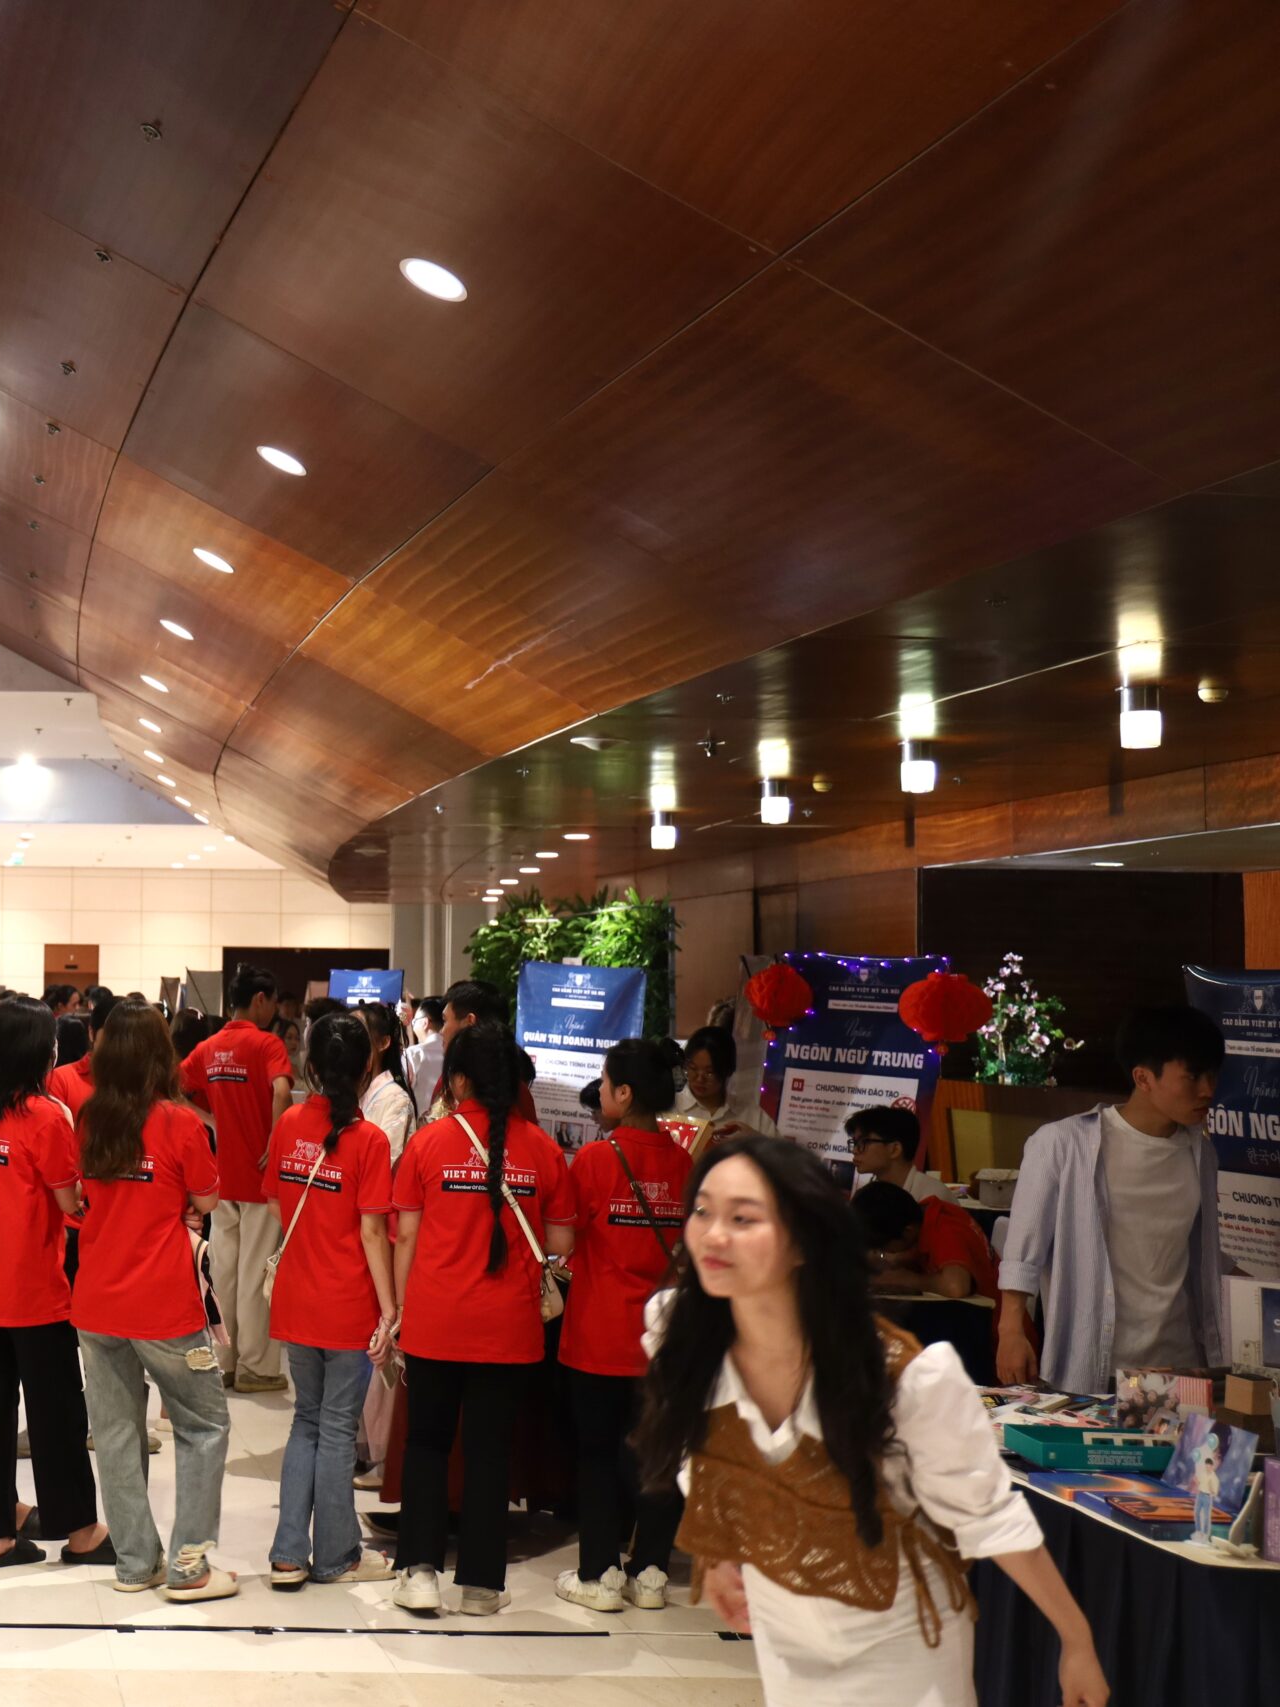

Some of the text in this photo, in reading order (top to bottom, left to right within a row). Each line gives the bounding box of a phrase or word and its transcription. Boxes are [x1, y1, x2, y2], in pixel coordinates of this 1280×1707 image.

[523, 1030, 619, 1049] QUẢN TRỊ DOANH NGH
[785, 1043, 924, 1069] NGÔN NGỮ TRUNG
[847, 1085, 867, 1095] TRÌNH
[868, 1086, 884, 1097] ĐÀO
[885, 1089, 899, 1100] TẠO
[1206, 1103, 1280, 1142] GÔN NG
[807, 1141, 818, 1149] CƠ
[819, 1142, 832, 1152] HỘI
[294, 1163, 306, 1172] MY
[308, 1165, 342, 1180] CLLEGE
[443, 1170, 535, 1184] VIET MY LLEGE
[610, 1203, 632, 1213] VIET
[1087, 1454, 1144, 1466] TREASURE
